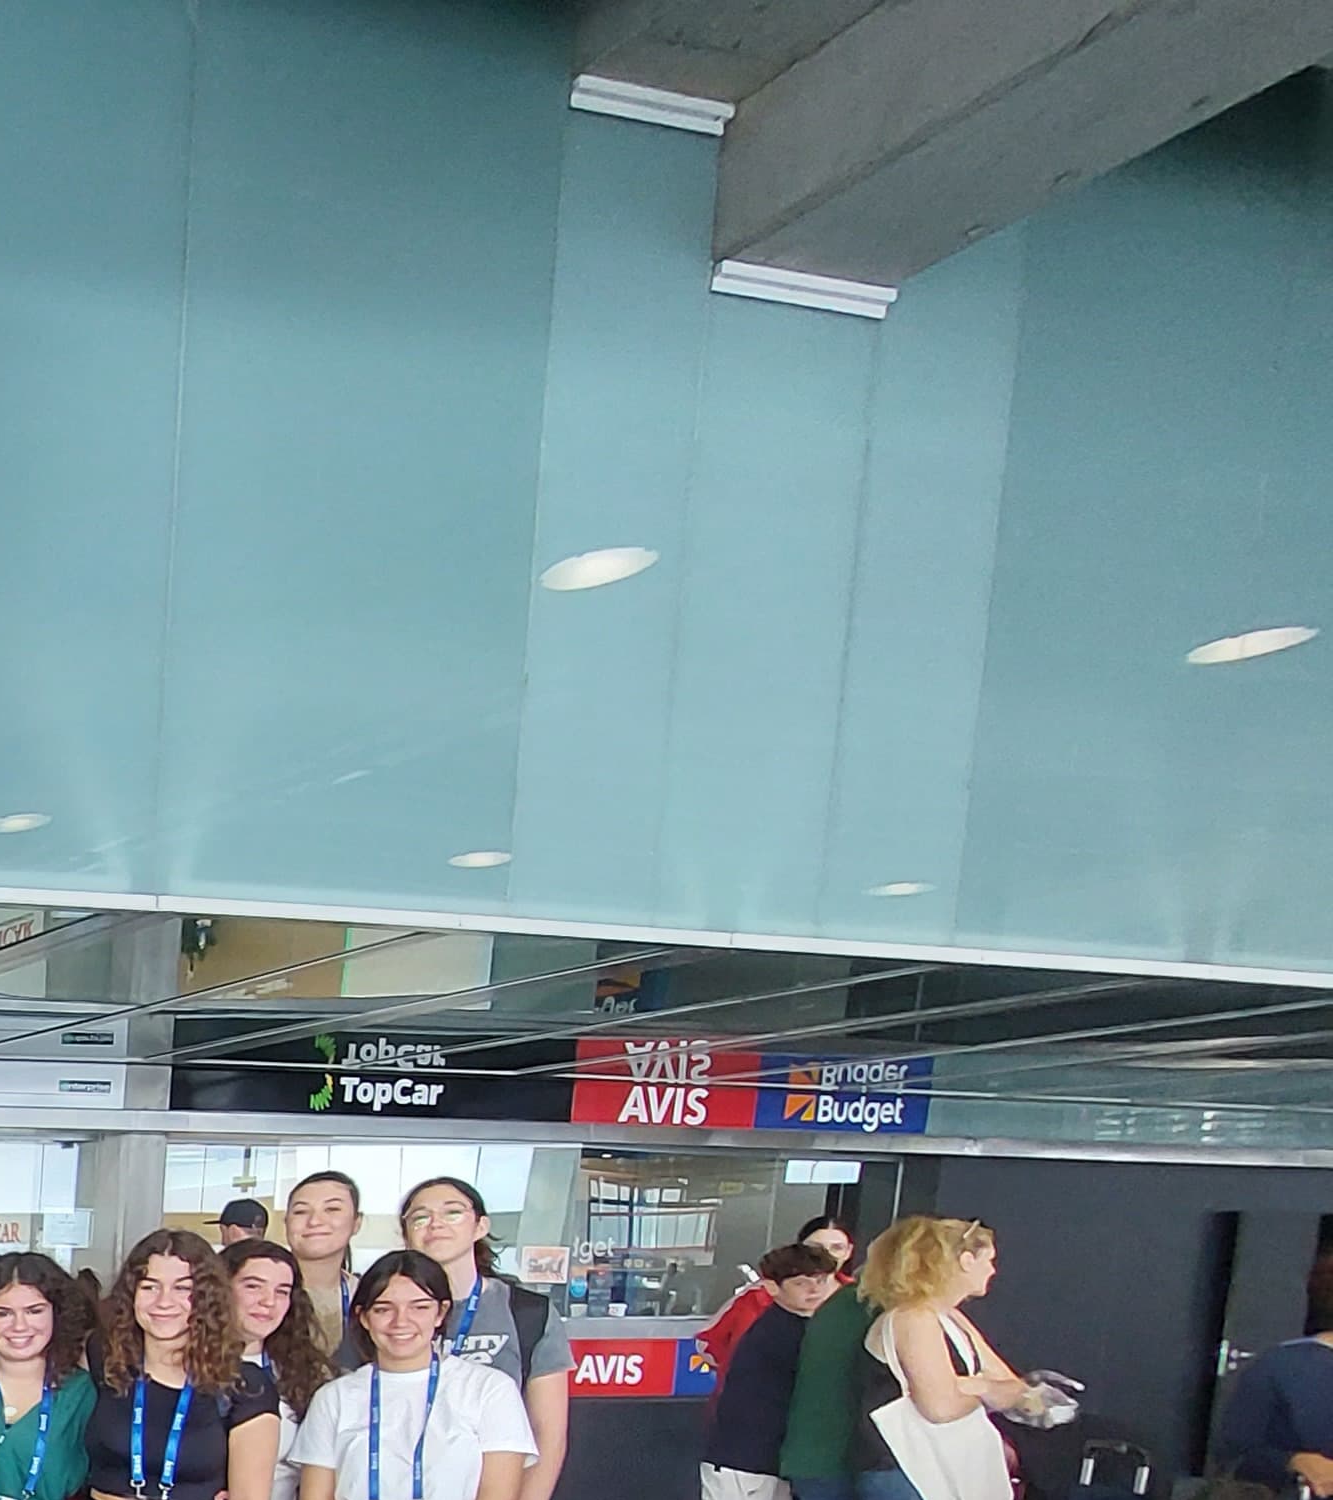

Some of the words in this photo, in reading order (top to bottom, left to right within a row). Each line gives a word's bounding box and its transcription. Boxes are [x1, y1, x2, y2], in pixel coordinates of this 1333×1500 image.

[340, 1077, 443, 1111] TopCar
[617, 1086, 709, 1126] AVIS
[817, 1095, 905, 1133] Budget
[575, 1354, 643, 1385] AVIS
